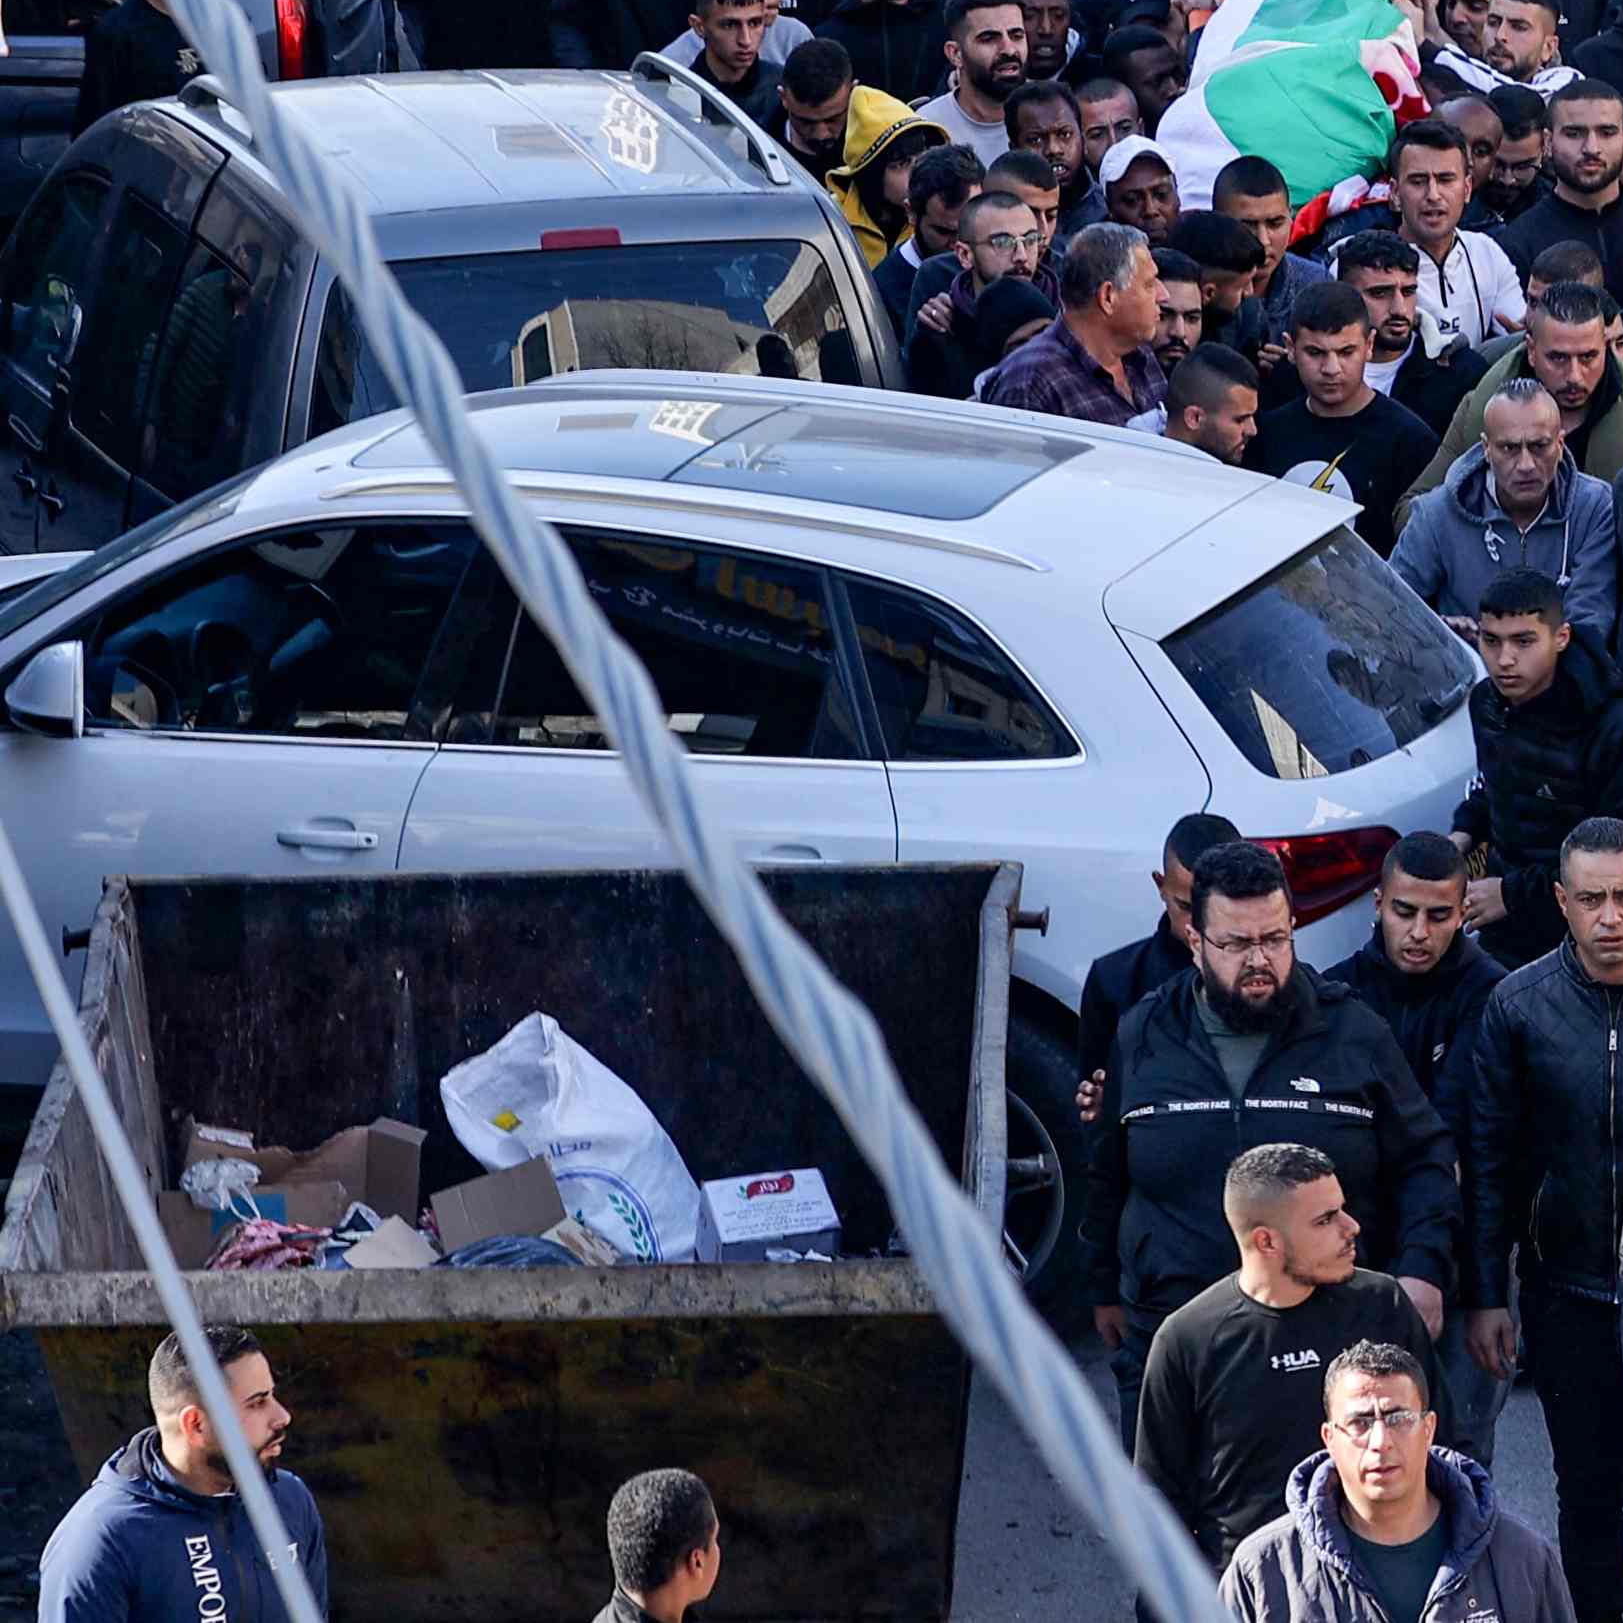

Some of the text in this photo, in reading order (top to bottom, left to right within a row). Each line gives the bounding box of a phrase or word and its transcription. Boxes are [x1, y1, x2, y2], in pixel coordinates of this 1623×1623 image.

[1168, 1101, 1230, 1112] THE NORTH FACE
[1245, 1099, 1309, 1110] THE NORTH FACE
